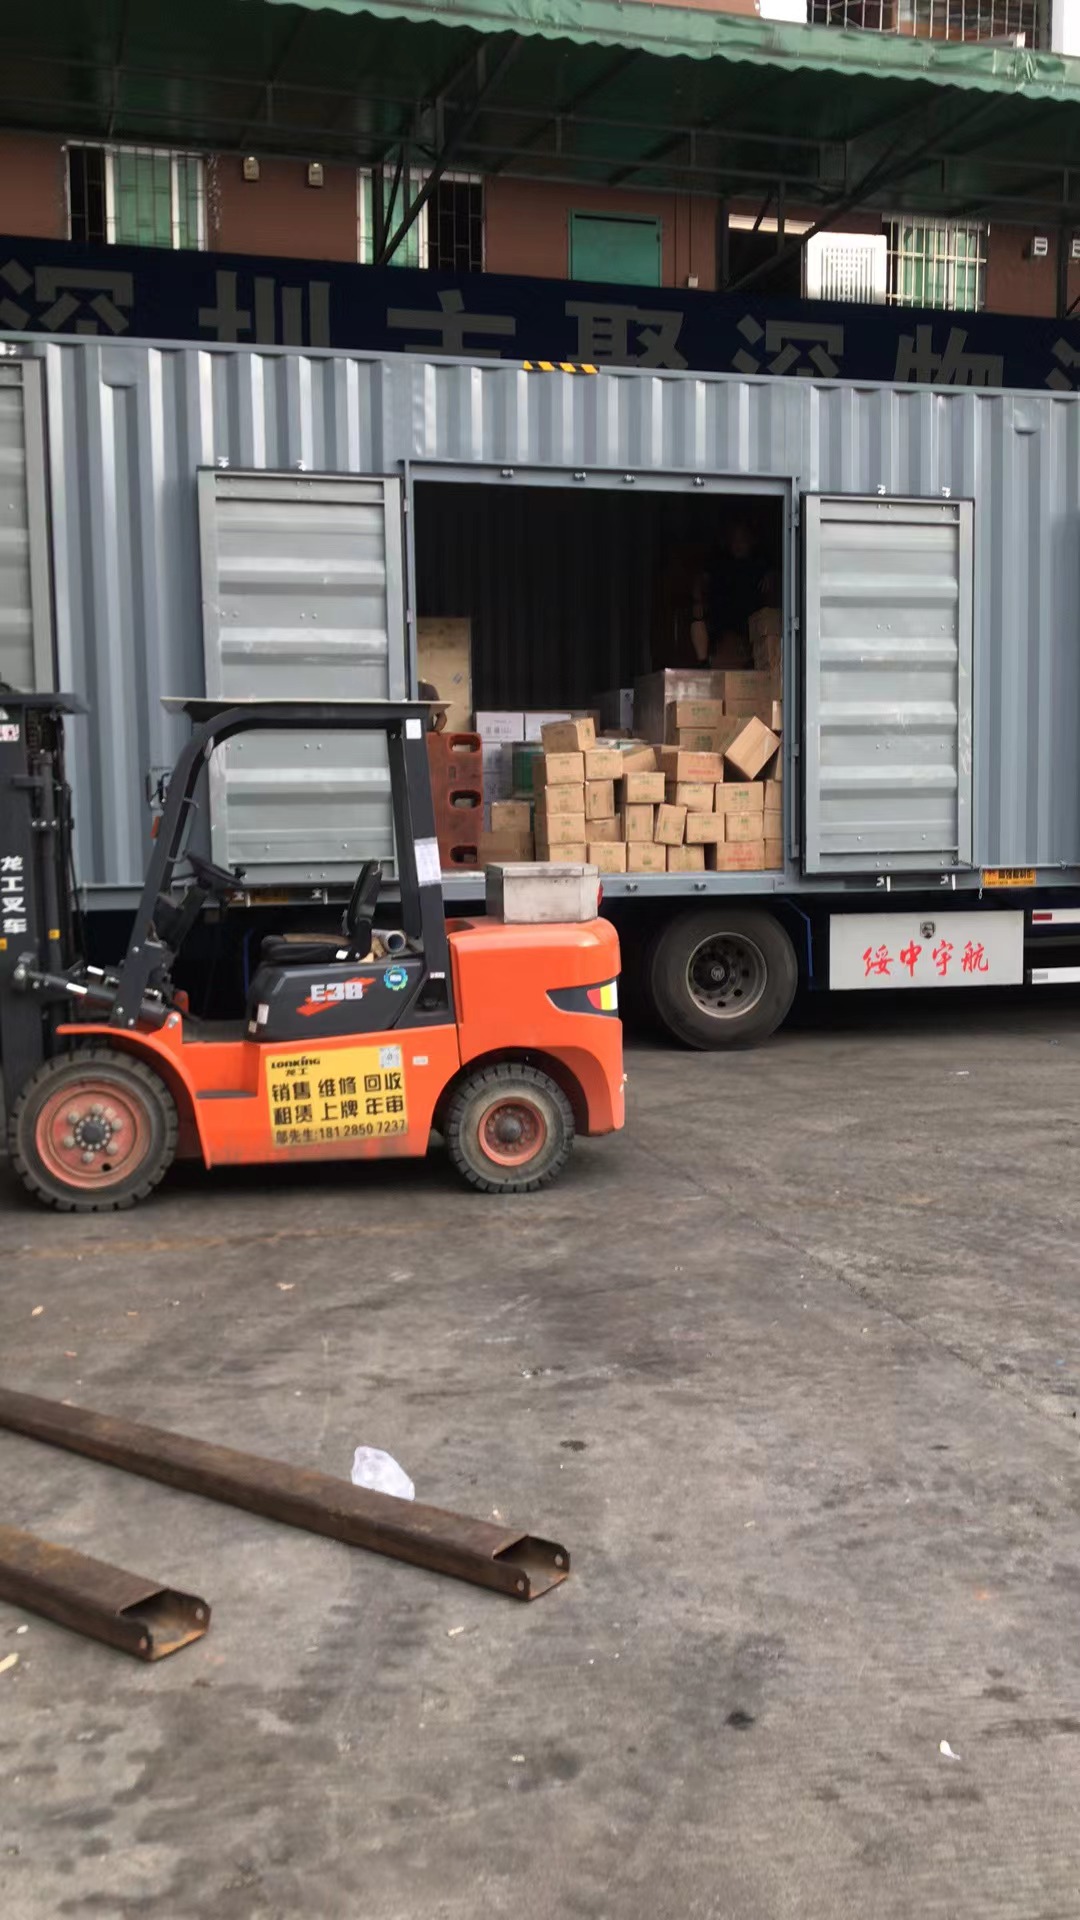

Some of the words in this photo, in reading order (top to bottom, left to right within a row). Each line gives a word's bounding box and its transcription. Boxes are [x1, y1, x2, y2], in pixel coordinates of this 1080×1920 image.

[1, 856, 27, 934] 龙工叉车
[862, 940, 989, 977] 绥中宇航
[272, 1081, 311, 1102] 销售
[318, 1076, 356, 1098] 维修
[364, 1072, 402, 1092] 回收
[274, 1104, 313, 1126] 租赁
[321, 1099, 358, 1120] 上牌
[365, 1095, 403, 1115] 年审
